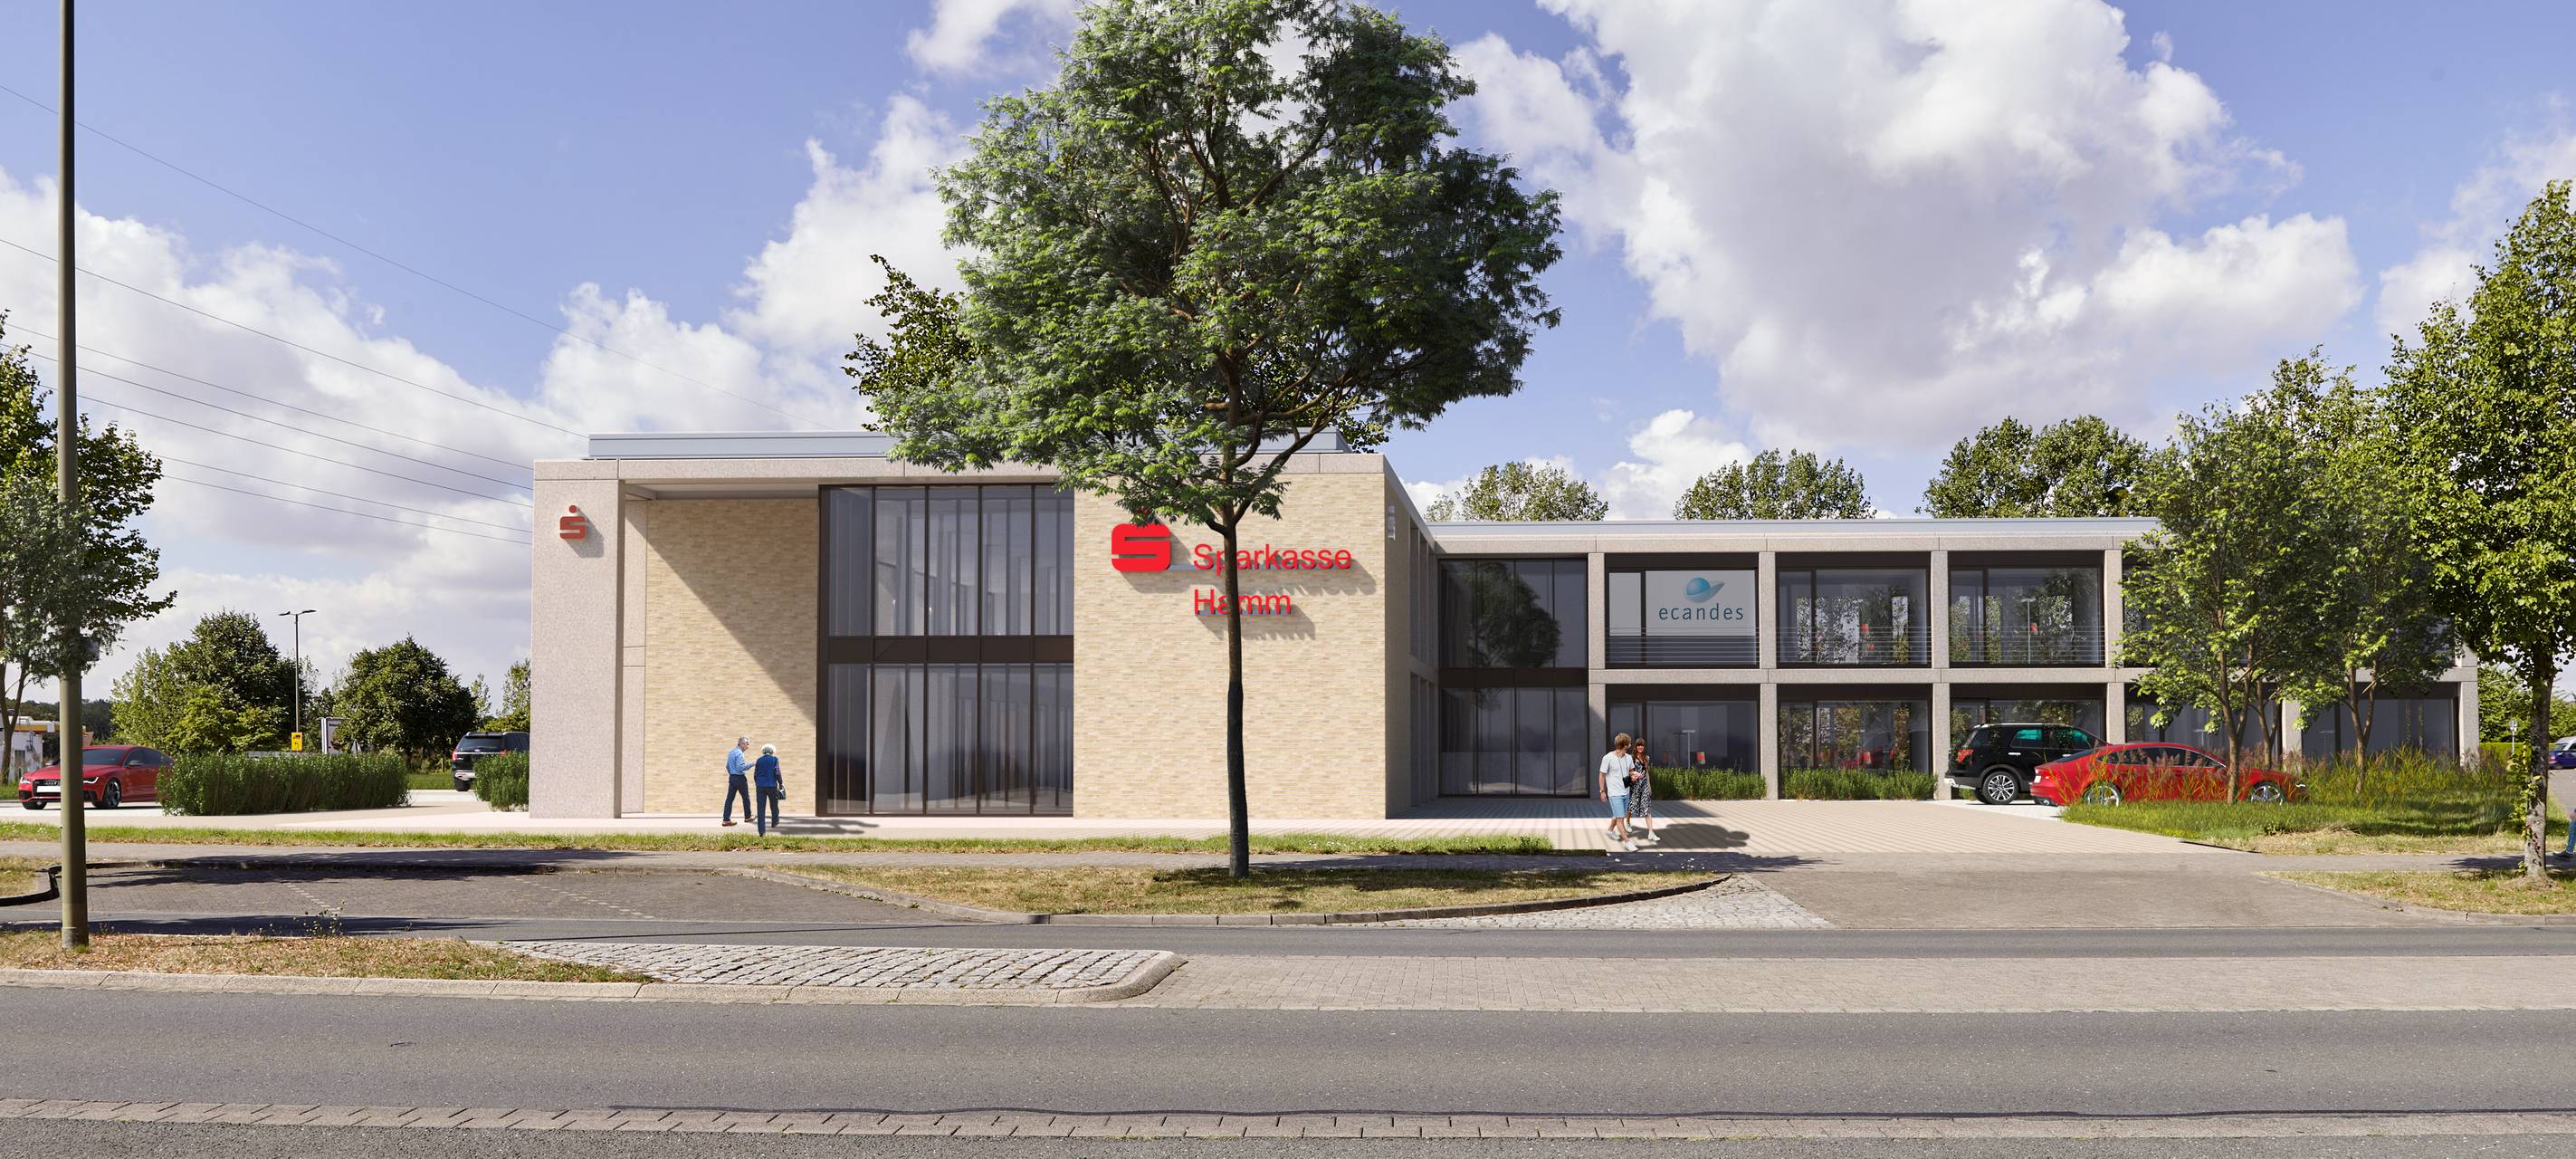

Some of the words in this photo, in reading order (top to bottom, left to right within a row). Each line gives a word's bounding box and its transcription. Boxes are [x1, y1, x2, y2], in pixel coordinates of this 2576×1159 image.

[1194, 543, 1351, 577] Sparkasse
[1194, 589, 1292, 615] Hamm
[1658, 603, 1744, 620] ecandes
